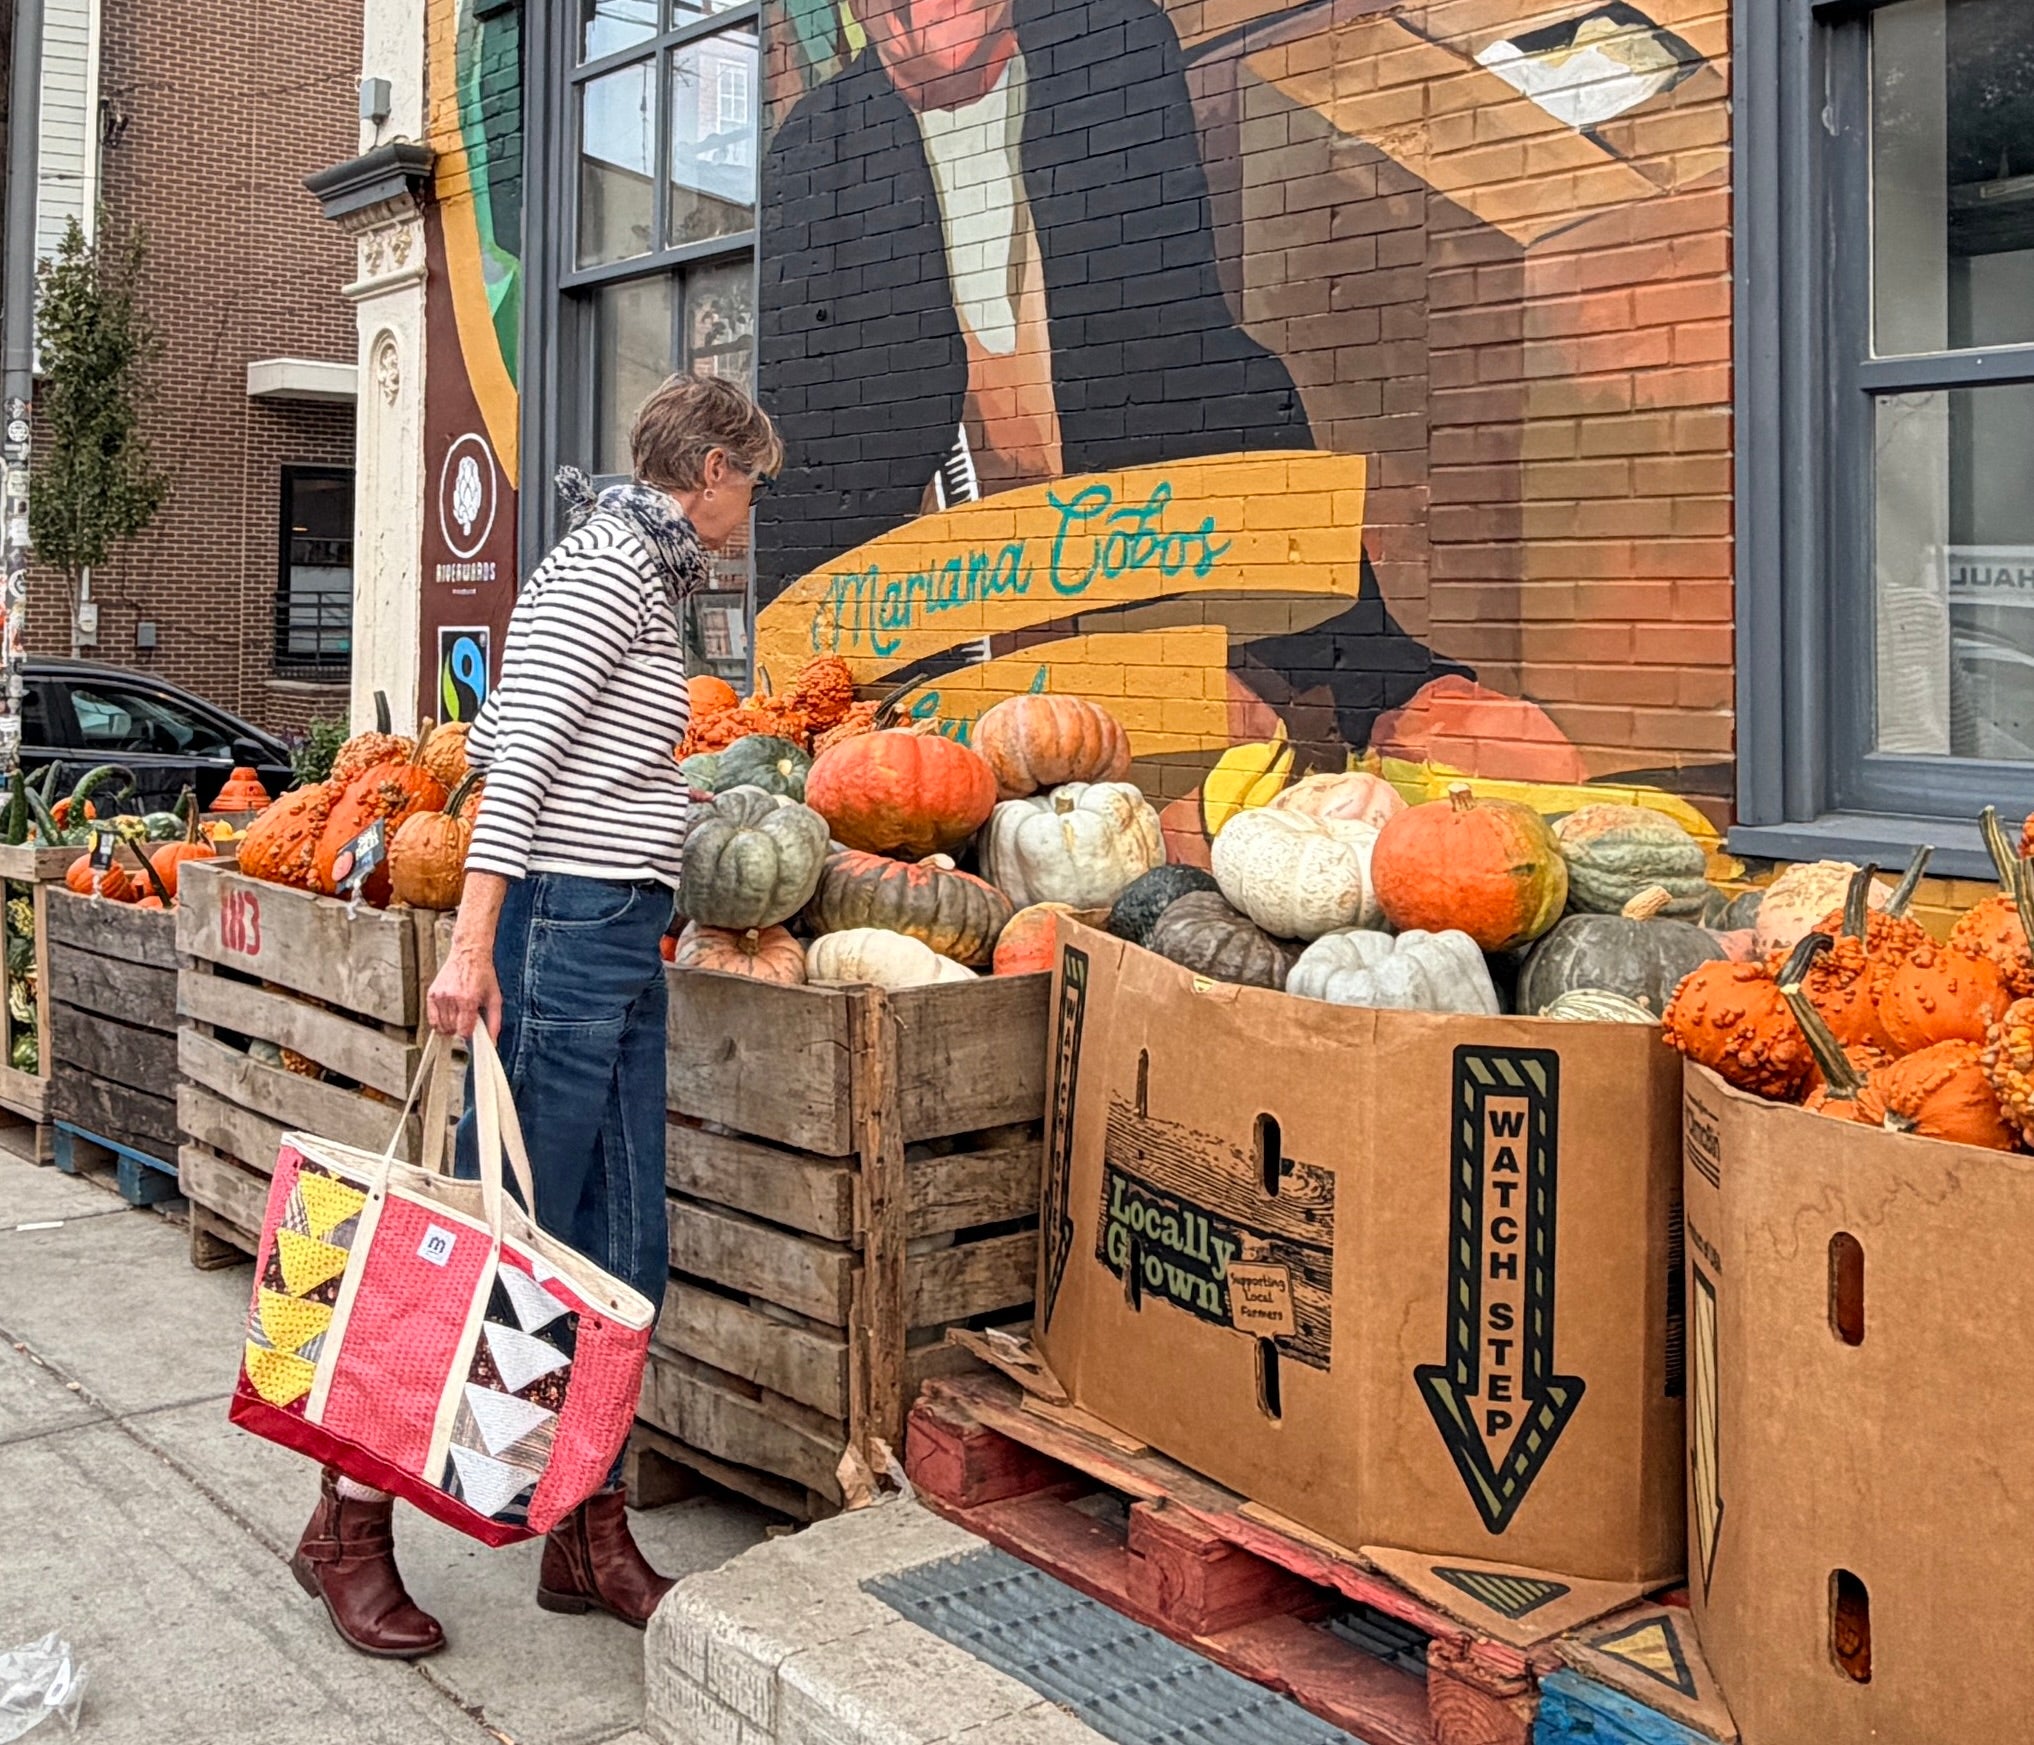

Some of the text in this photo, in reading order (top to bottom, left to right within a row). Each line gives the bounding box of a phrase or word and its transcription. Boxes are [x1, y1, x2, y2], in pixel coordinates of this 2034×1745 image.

[810, 481, 1232, 657] Mariana Cobos
[1107, 1221, 1223, 1316] Gown
[1110, 1174, 1236, 1281] Locally
[1486, 1110, 1526, 1437] WATCH STEP
[1230, 1272, 1286, 1293] Supporting
[1240, 1305, 1283, 1321] Farmers
[1242, 1289, 1275, 1303] Local
